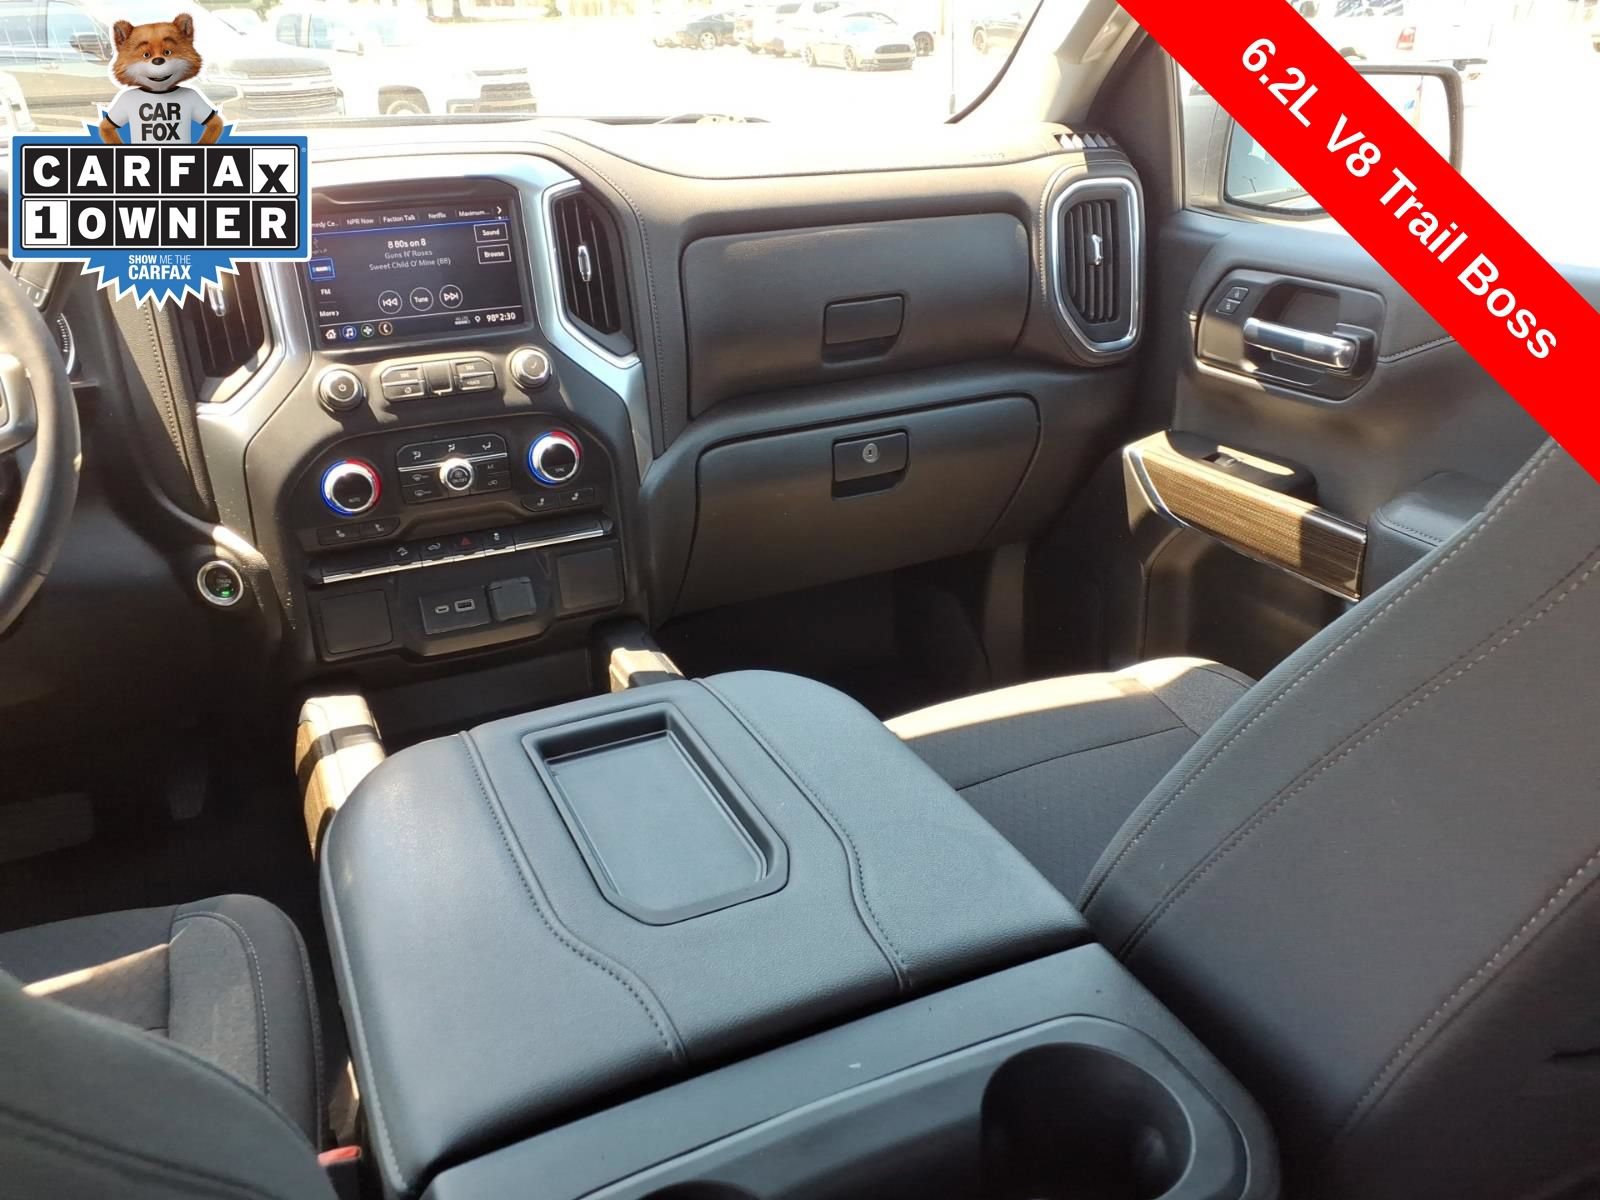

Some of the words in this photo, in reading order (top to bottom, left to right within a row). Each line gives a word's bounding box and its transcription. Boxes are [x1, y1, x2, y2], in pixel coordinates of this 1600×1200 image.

[383, 215, 404, 223] Faction
[482, 228, 500, 236] Sound
[420, 238, 427, 246] 8
[385, 250, 402, 258] Guns
[369, 262, 391, 271] Sweet
[391, 261, 410, 269] Child
[499, 312, 516, 321] 2:30
